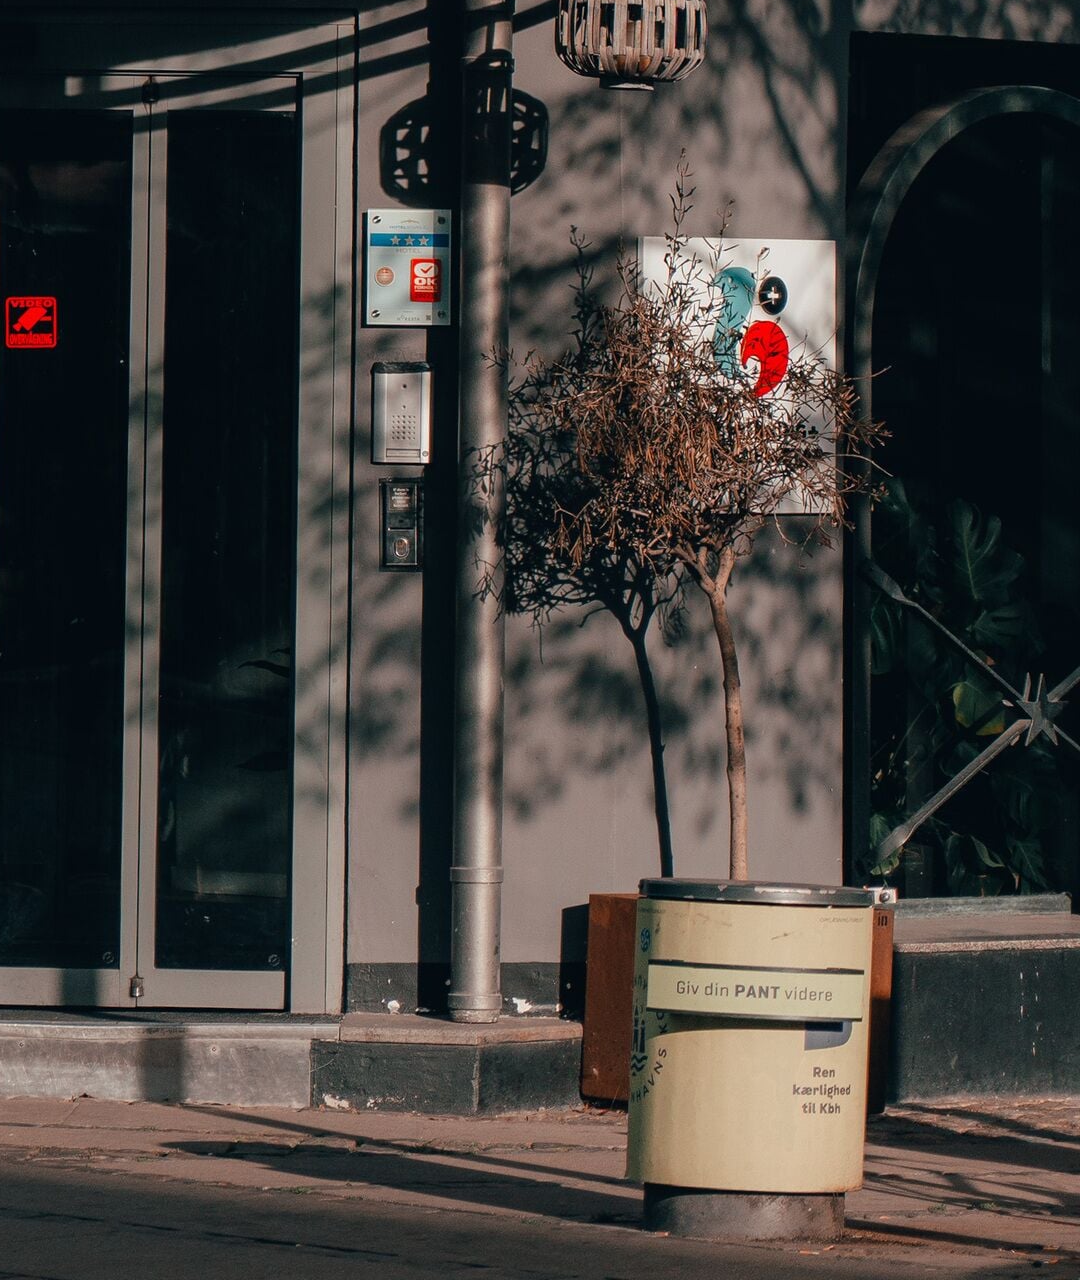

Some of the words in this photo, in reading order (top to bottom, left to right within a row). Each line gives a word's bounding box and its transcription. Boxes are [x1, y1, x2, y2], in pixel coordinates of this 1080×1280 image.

[11, 299, 53, 308] VIDEO
[676, 980, 699, 995] Giv
[704, 982, 729, 997] din
[734, 984, 780, 999] PANT
[784, 987, 833, 1001] videre
[813, 1066, 836, 1078] Ren
[792, 1083, 852, 1099] kærlighed
[802, 1102, 817, 1114] til
[819, 1102, 841, 1114] Kbh
